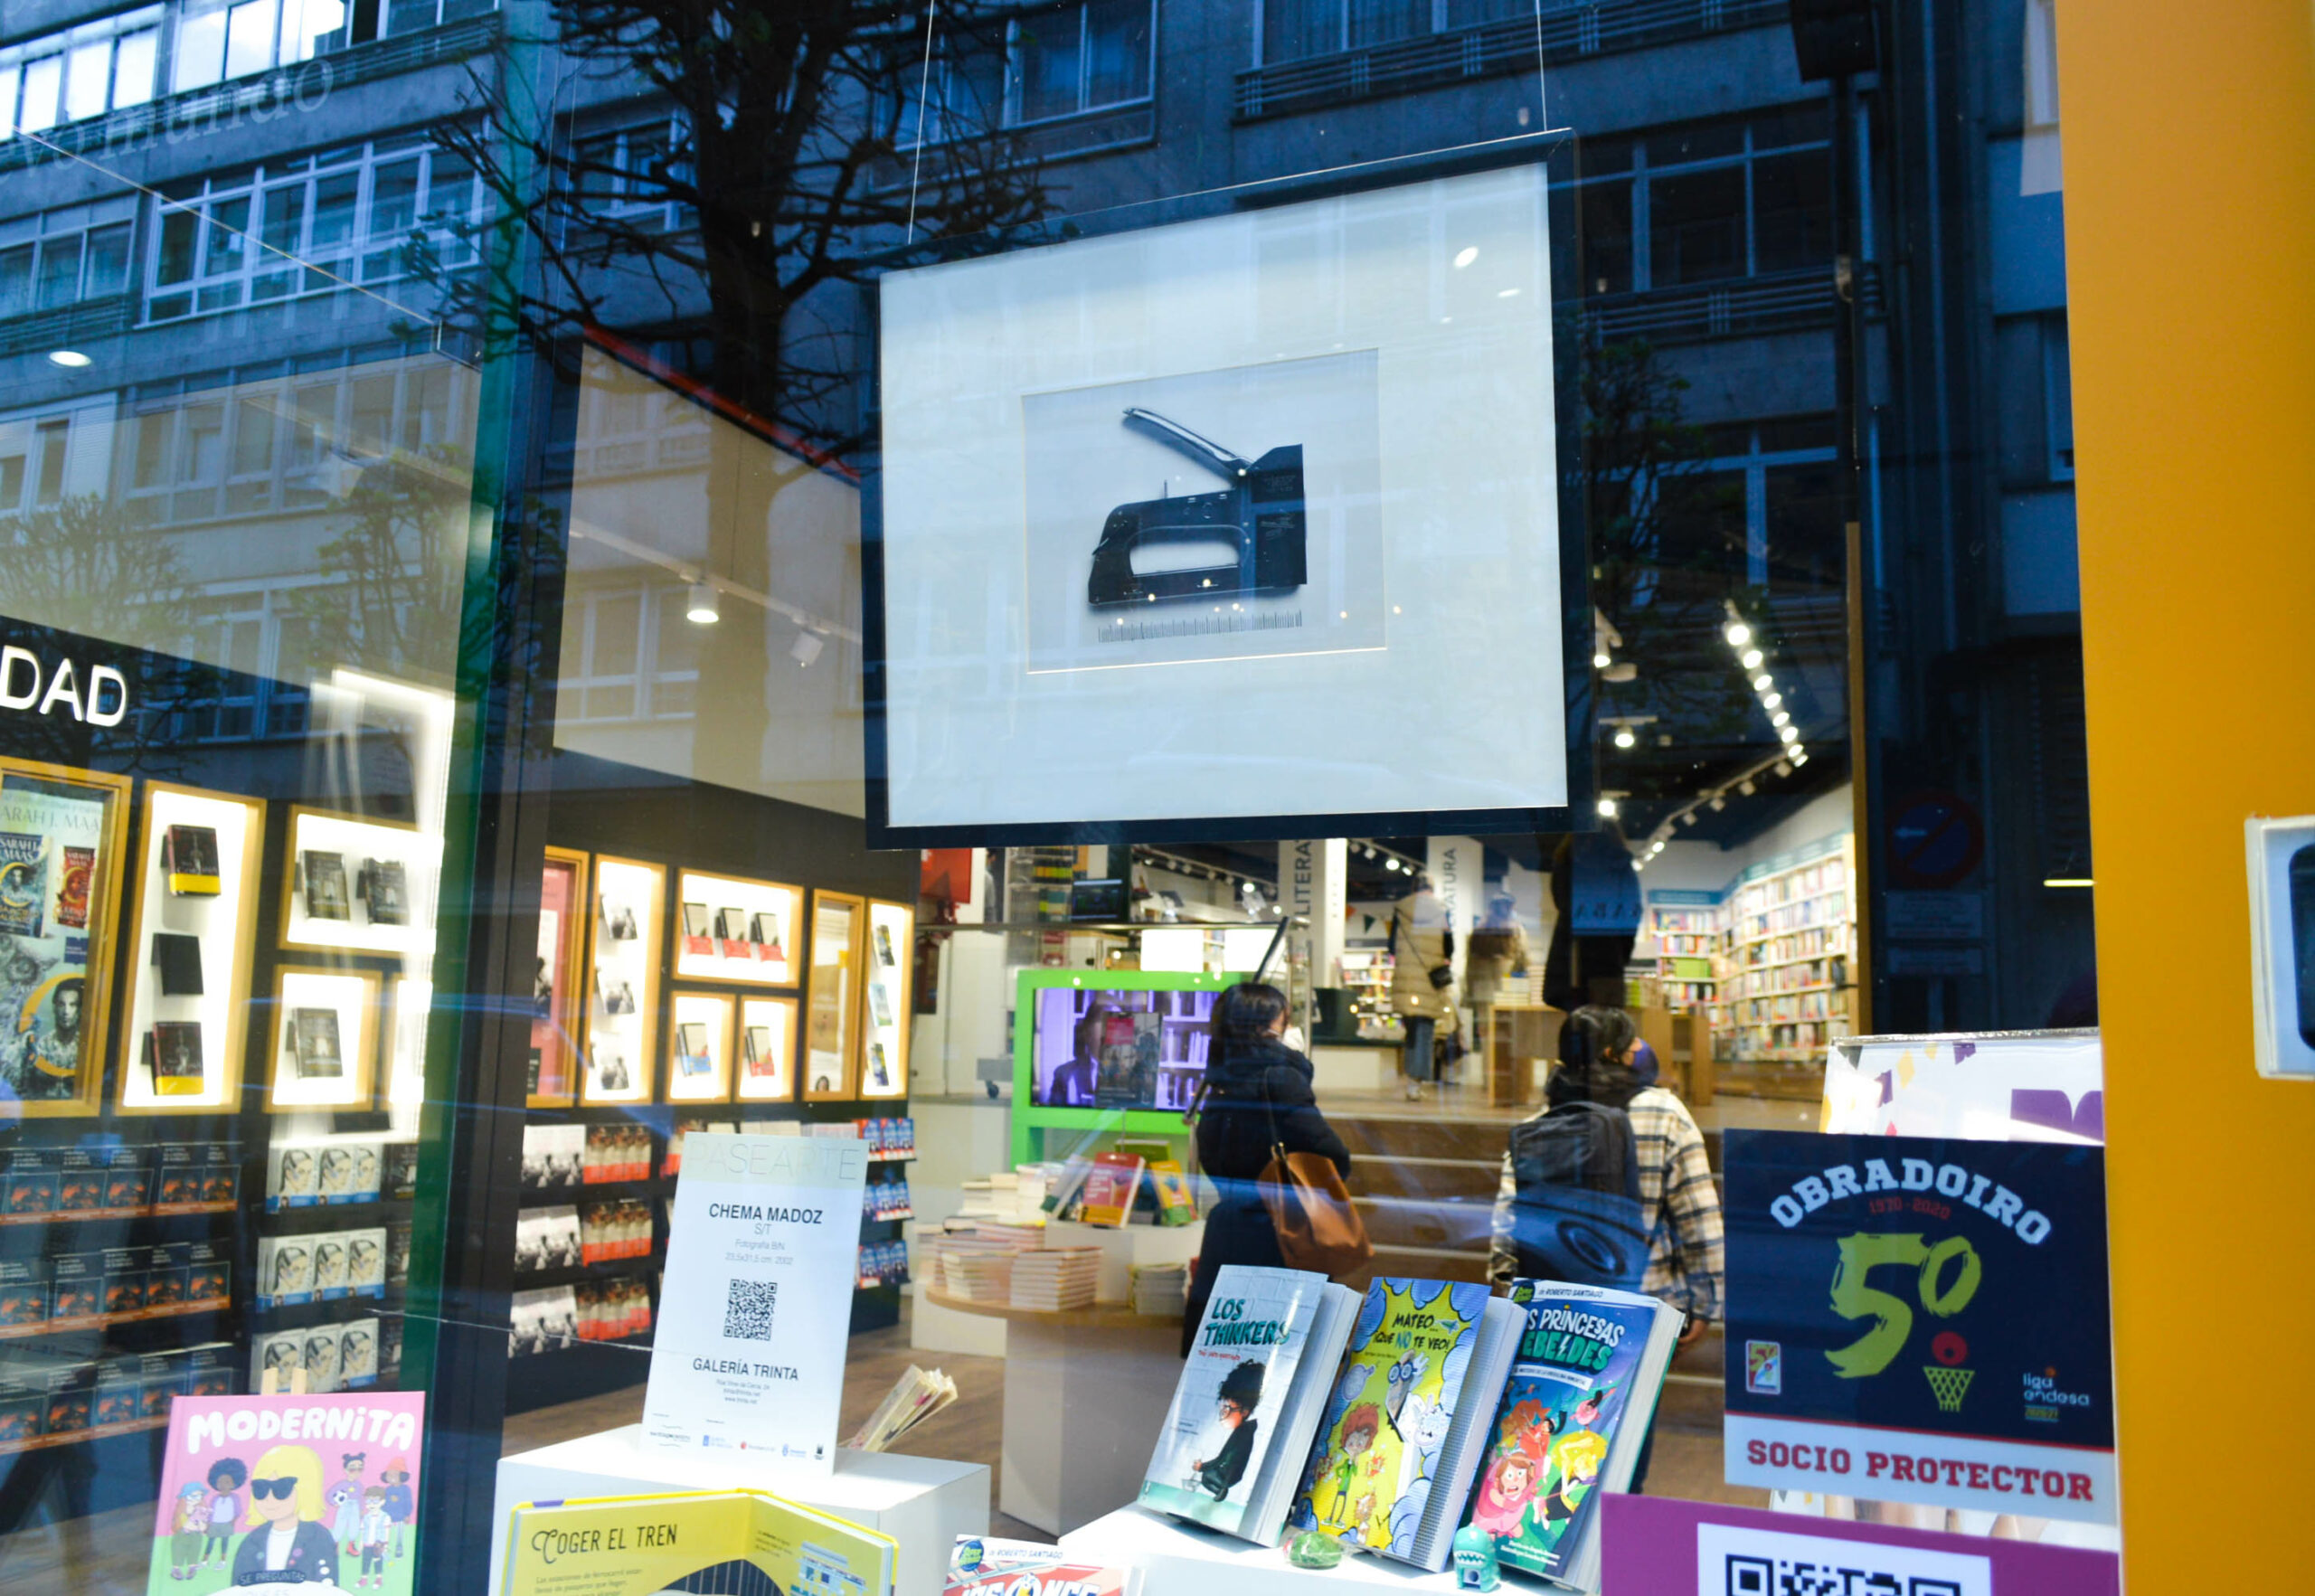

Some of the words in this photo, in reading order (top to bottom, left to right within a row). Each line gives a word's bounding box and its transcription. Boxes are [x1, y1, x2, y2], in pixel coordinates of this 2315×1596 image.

[0, 644, 128, 727] DAD
[1294, 840, 1311, 915] LITERA
[1444, 846, 1457, 911] ATURA
[686, 1140, 862, 1180] PASEARTE
[709, 1203, 762, 1221] CHEMA
[768, 1206, 823, 1224] MADOZ
[1770, 1157, 2051, 1245] OBRADOIRO
[753, 1223, 772, 1235] S/T
[1211, 1297, 1246, 1321] LOS
[1545, 1289, 1572, 1297] ROBERTO
[1573, 1289, 1603, 1298] SANTIAGO
[1204, 1320, 1290, 1346] THINKERS
[1395, 1330, 1413, 1349] NO
[1413, 1336, 1425, 1348] TE
[1428, 1337, 1450, 1353] VEO!
[1539, 1305, 1625, 1347] PRINCESAS
[1522, 1330, 1613, 1371] EBELDES
[693, 1357, 749, 1375] GALERÍA
[753, 1364, 798, 1381] TRINTA
[2024, 1389, 2090, 1406] endesa
[1747, 1439, 1851, 1475] SOCIO
[1866, 1451, 2093, 1502] PROTECTOR
[532, 1529, 600, 1564] COGER
[608, 1528, 627, 1551] EL
[637, 1524, 677, 1547] TREN
[997, 1549, 1026, 1557] ROBERTO
[1028, 1550, 1063, 1560] SANTIAGO
